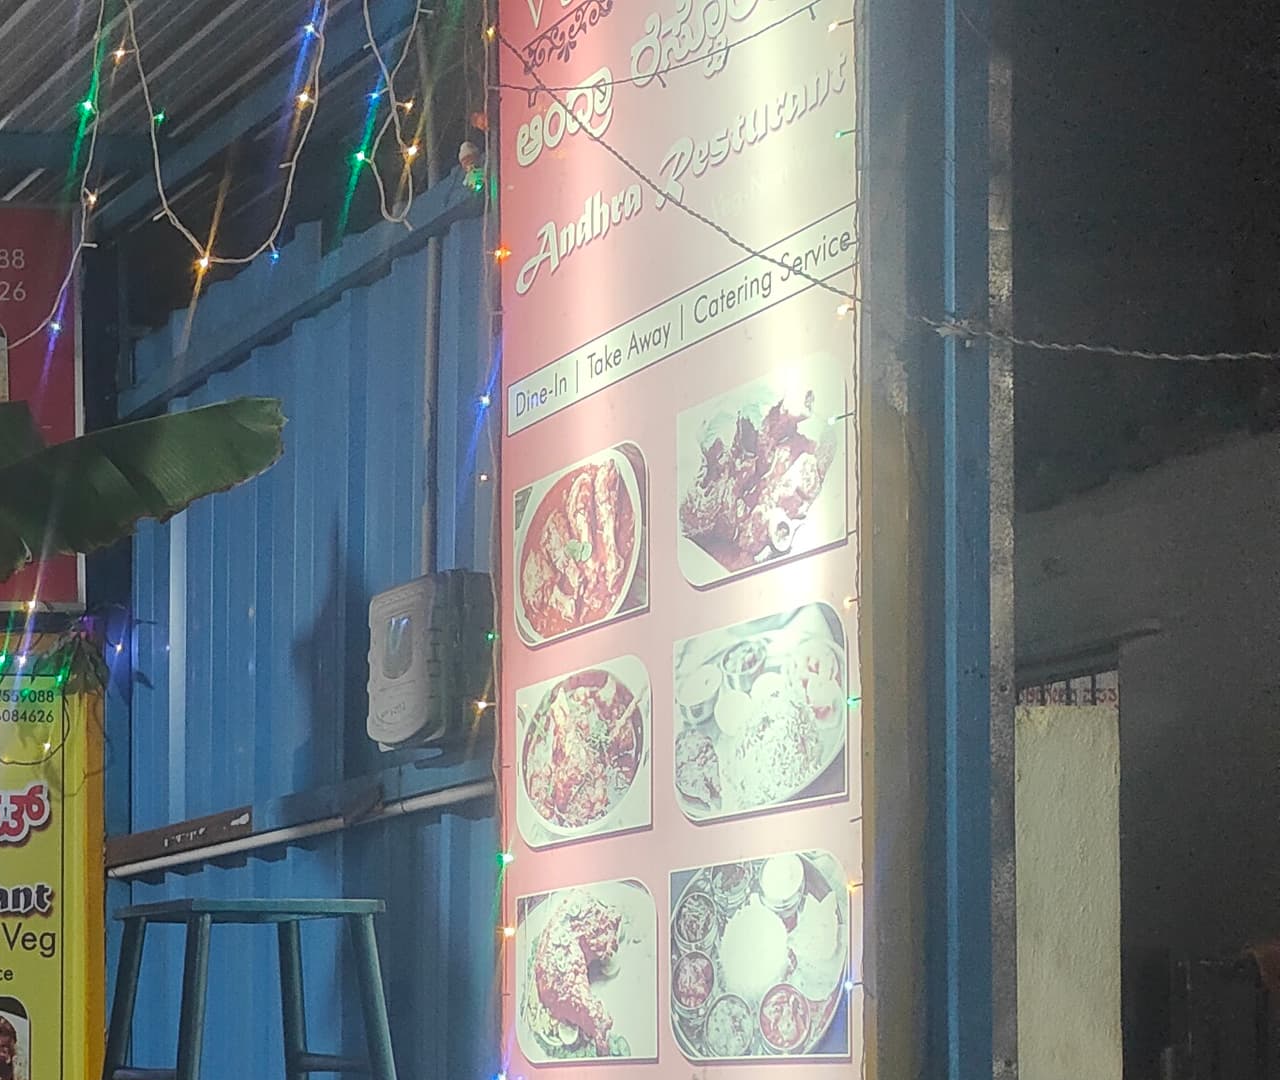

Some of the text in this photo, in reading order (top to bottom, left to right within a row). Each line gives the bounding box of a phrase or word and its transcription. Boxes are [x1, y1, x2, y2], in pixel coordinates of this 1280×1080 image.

[516, 183, 642, 295] Andhra
[515, 230, 851, 418] Dine-In Take Away Catering Service
[1, 920, 57, 958] Veg
